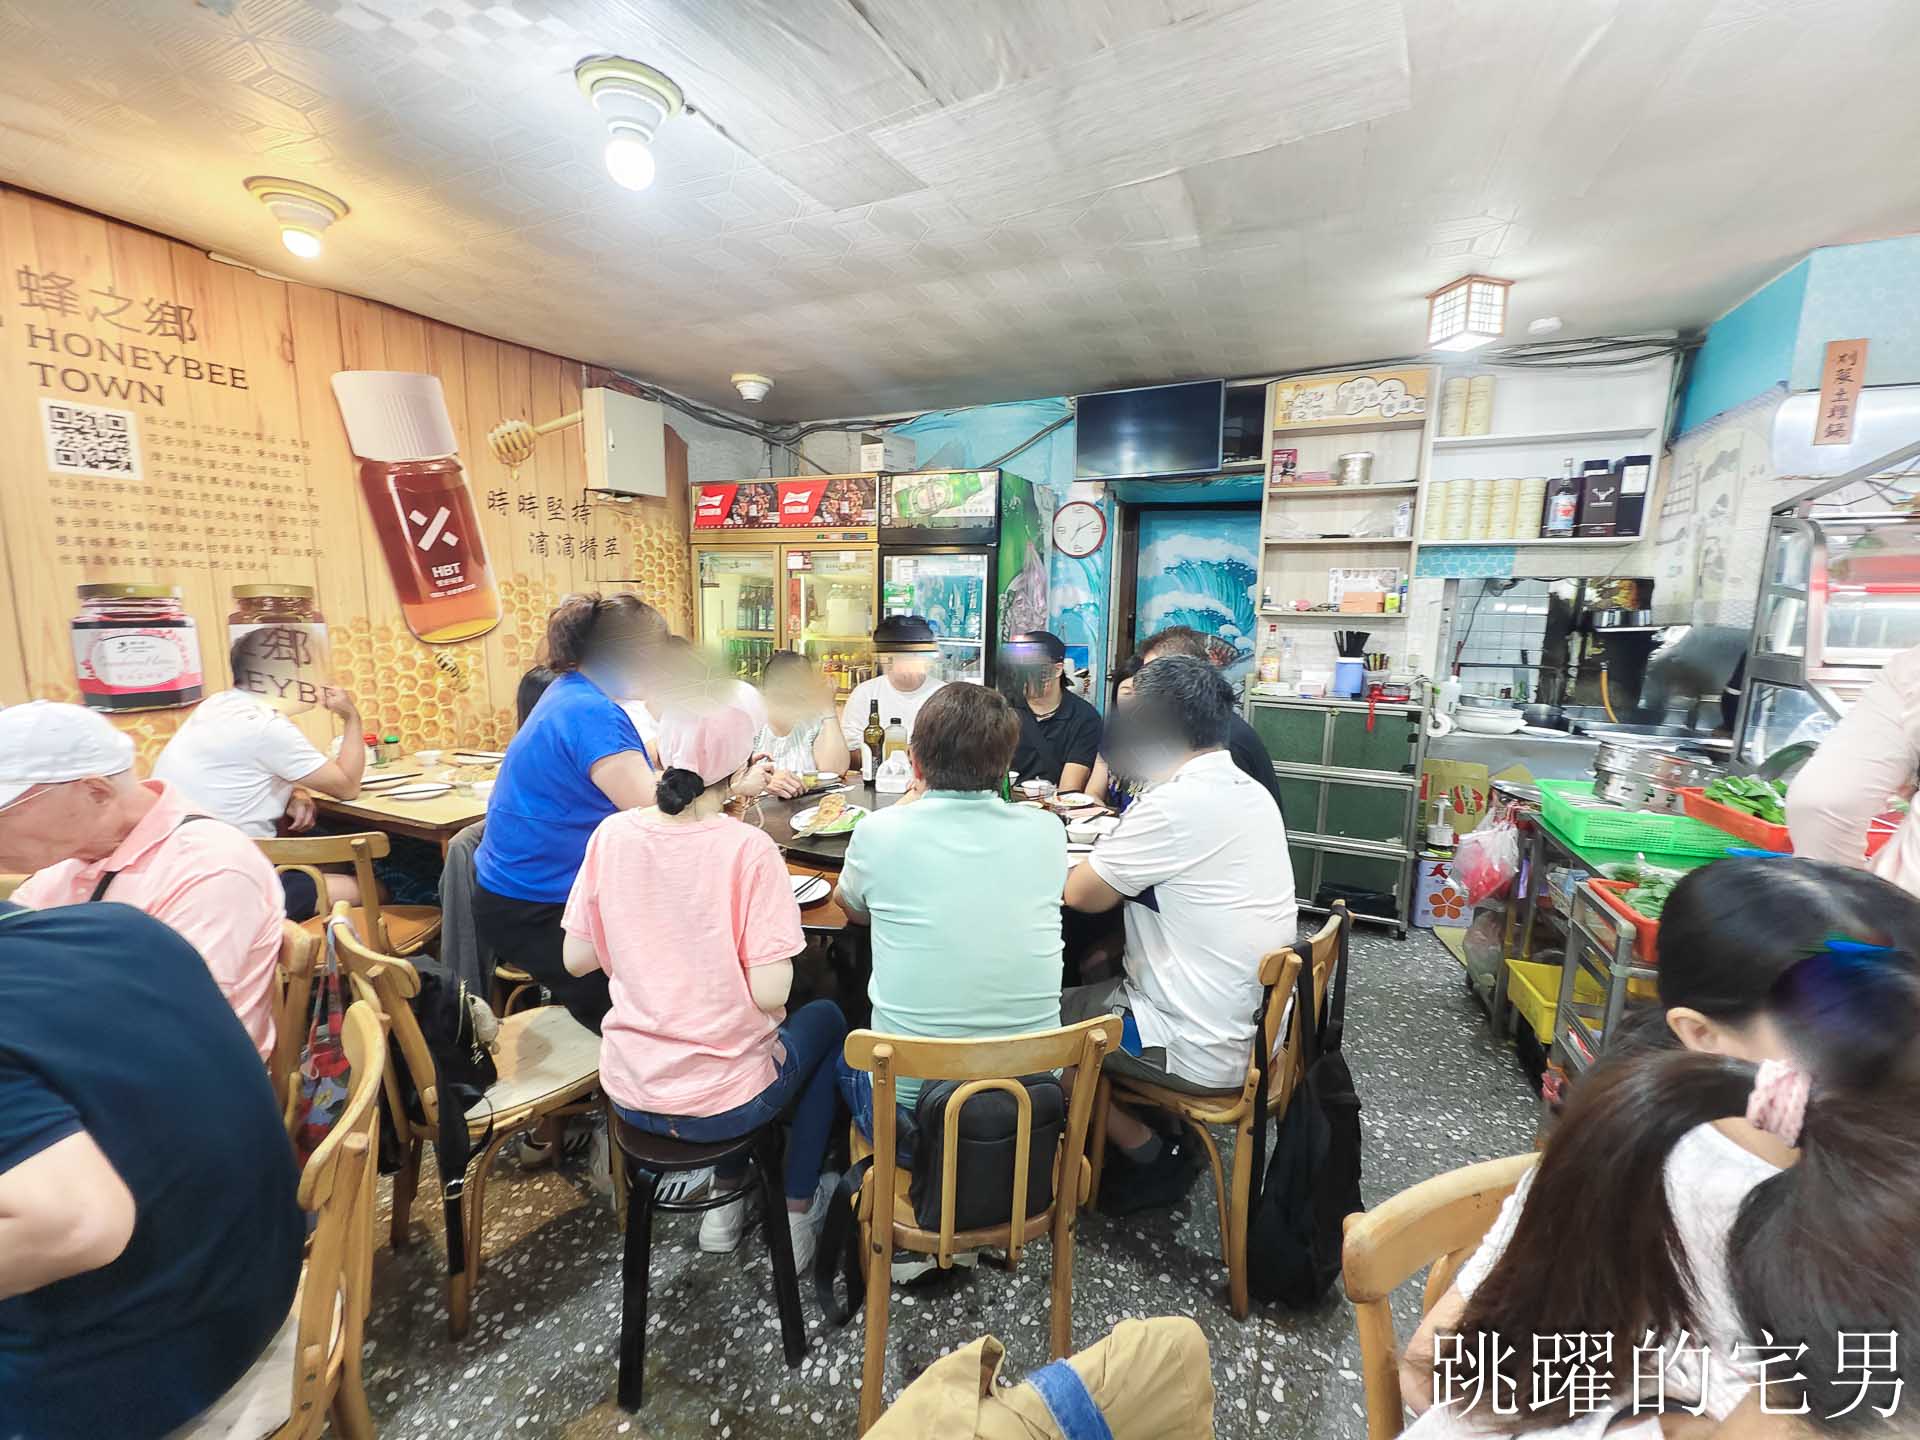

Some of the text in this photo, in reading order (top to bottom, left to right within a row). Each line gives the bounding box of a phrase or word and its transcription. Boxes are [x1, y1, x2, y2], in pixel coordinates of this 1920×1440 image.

[16, 264, 197, 344] 蜂之鄉
[25, 323, 249, 390] HONEYBEE
[28, 361, 165, 407] TOWN
[487, 488, 593, 526] 時時堅持
[528, 531, 621, 560] 滴滴精萃
[431, 562, 462, 578] HBT
